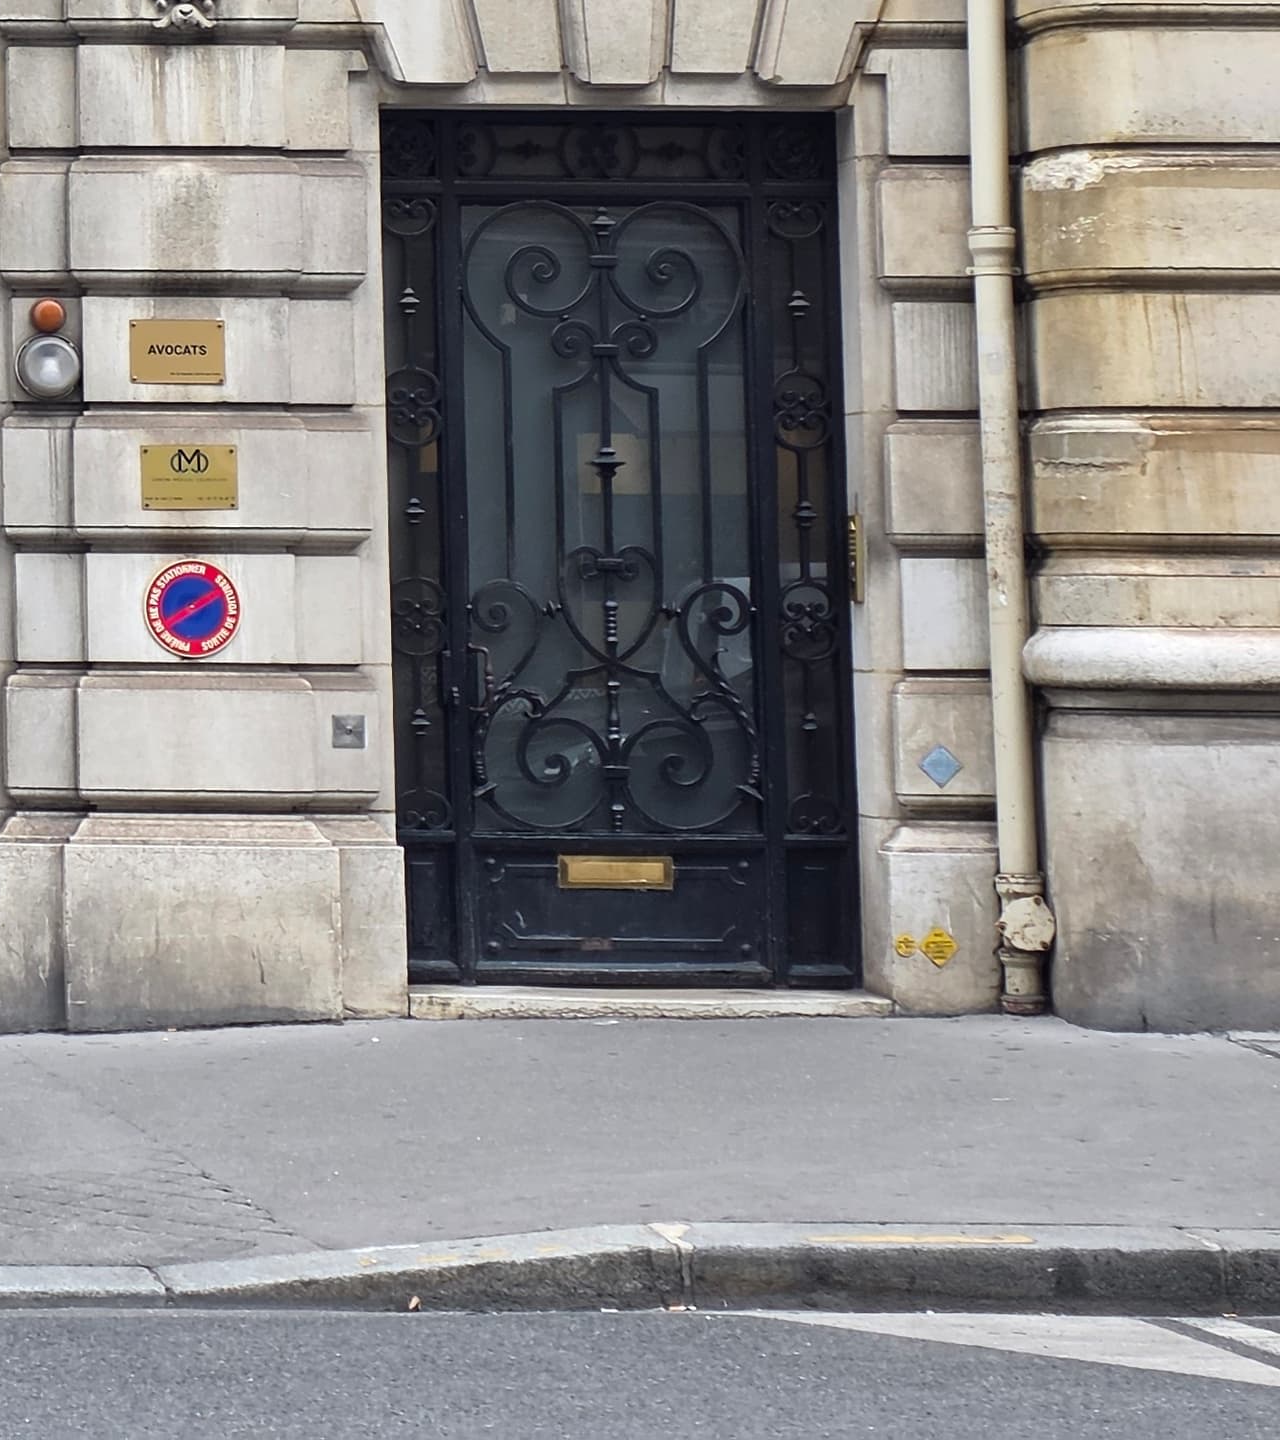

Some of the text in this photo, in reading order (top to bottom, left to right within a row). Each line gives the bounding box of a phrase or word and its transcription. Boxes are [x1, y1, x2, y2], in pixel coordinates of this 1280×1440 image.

[147, 344, 208, 356] AVOCATS
[156, 564, 206, 588] STATIONNER
[149, 586, 162, 606] PAS
[201, 574, 237, 651] SORTIE DE VOITURES
[152, 619, 165, 633] DE
